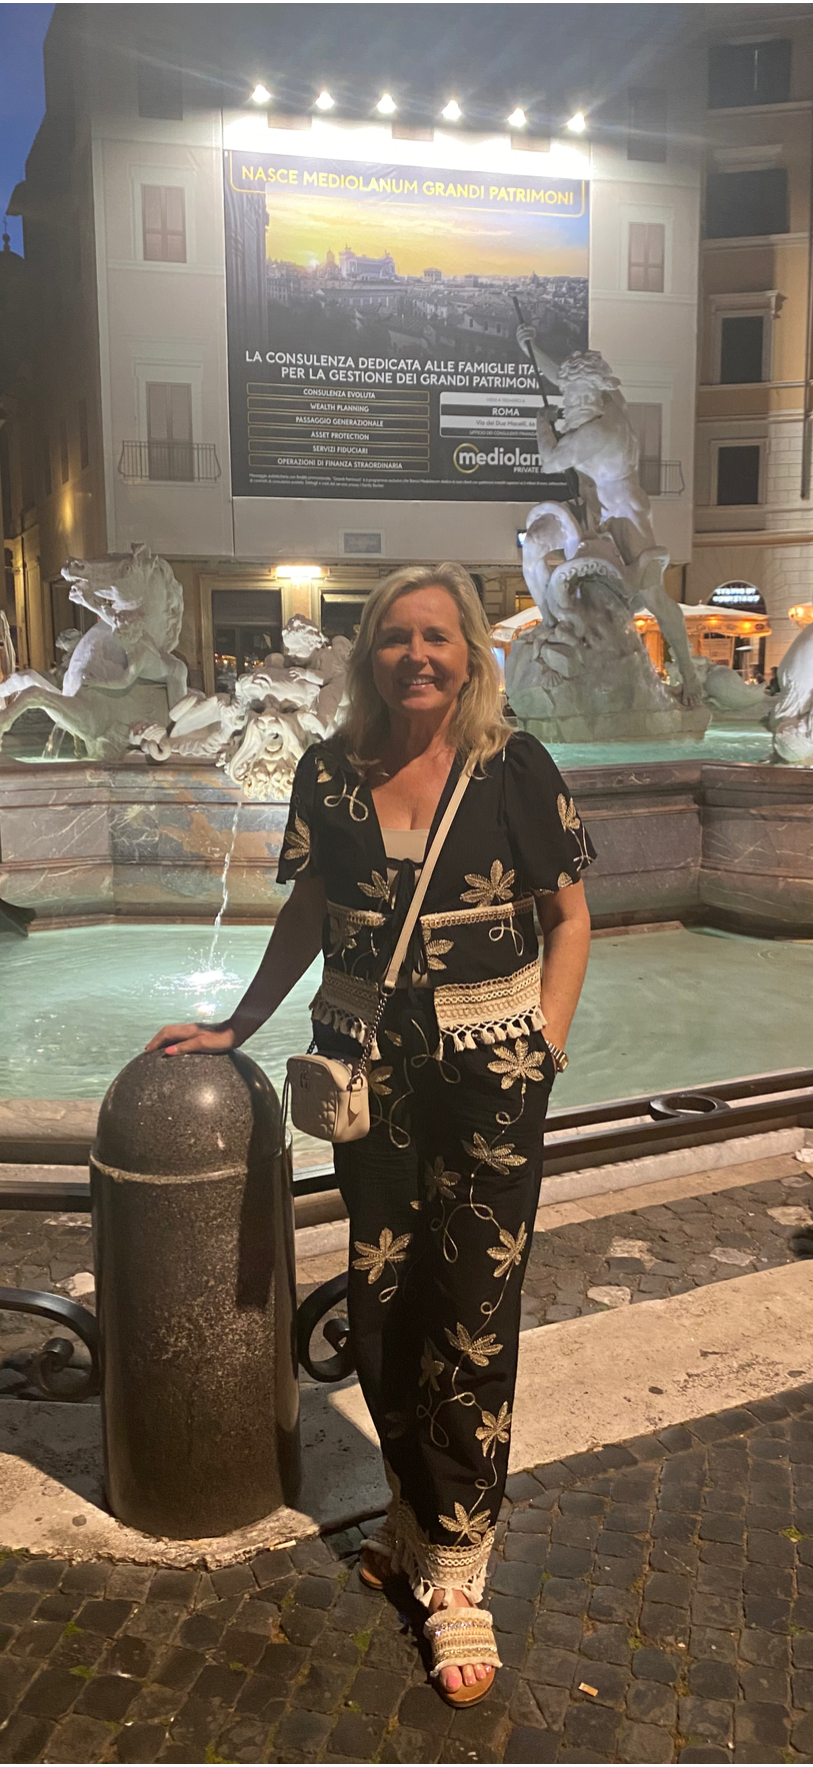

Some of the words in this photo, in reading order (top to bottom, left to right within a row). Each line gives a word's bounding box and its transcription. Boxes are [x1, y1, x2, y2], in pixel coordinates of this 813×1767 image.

[242, 165, 298, 186] NASCE
[303, 170, 418, 195] MEDIOLANUM
[422, 180, 485, 199] GRANDI
[489, 186, 574, 206] PATRIMONI
[245, 350, 262, 363] LA
[266, 352, 355, 369] CONSULENZA
[358, 357, 422, 373] DEDICATA
[424, 361, 455, 373] ALLE
[458, 362, 515, 375] FAMIGLIE
[518, 363, 543, 376] ITA
[281, 367, 305, 379] PER
[309, 368, 325, 380] LA
[329, 369, 392, 384] GESTIONE
[396, 373, 417, 385] DEI
[420, 374, 469, 387] GRANDI
[473, 375, 540, 390] PATRIMONI
[303, 388, 346, 398] CONSULENZA
[347, 391, 376, 399] EVOLUTA
[310, 402, 335, 411] WEALTH
[337, 404, 369, 413] PLANNING
[491, 407, 520, 417] ROMA
[295, 416, 331, 426] PASSAGGIO
[332, 418, 384, 428] GENERAZIONALE
[310, 431, 330, 439] ASSET
[331, 432, 370, 441] PROTECTION
[312, 445, 336, 454] SERVIZI
[337, 446, 369, 455] FIDUCIARI
[458, 447, 542, 466] mediolan
[277, 457, 316, 467] OPERAZIONI
[317, 459, 324, 467] DI
[325, 459, 353, 468] FINANZA
[353, 460, 403, 470] STRAORDINARIA
[513, 466, 539, 474] PRIVATE
